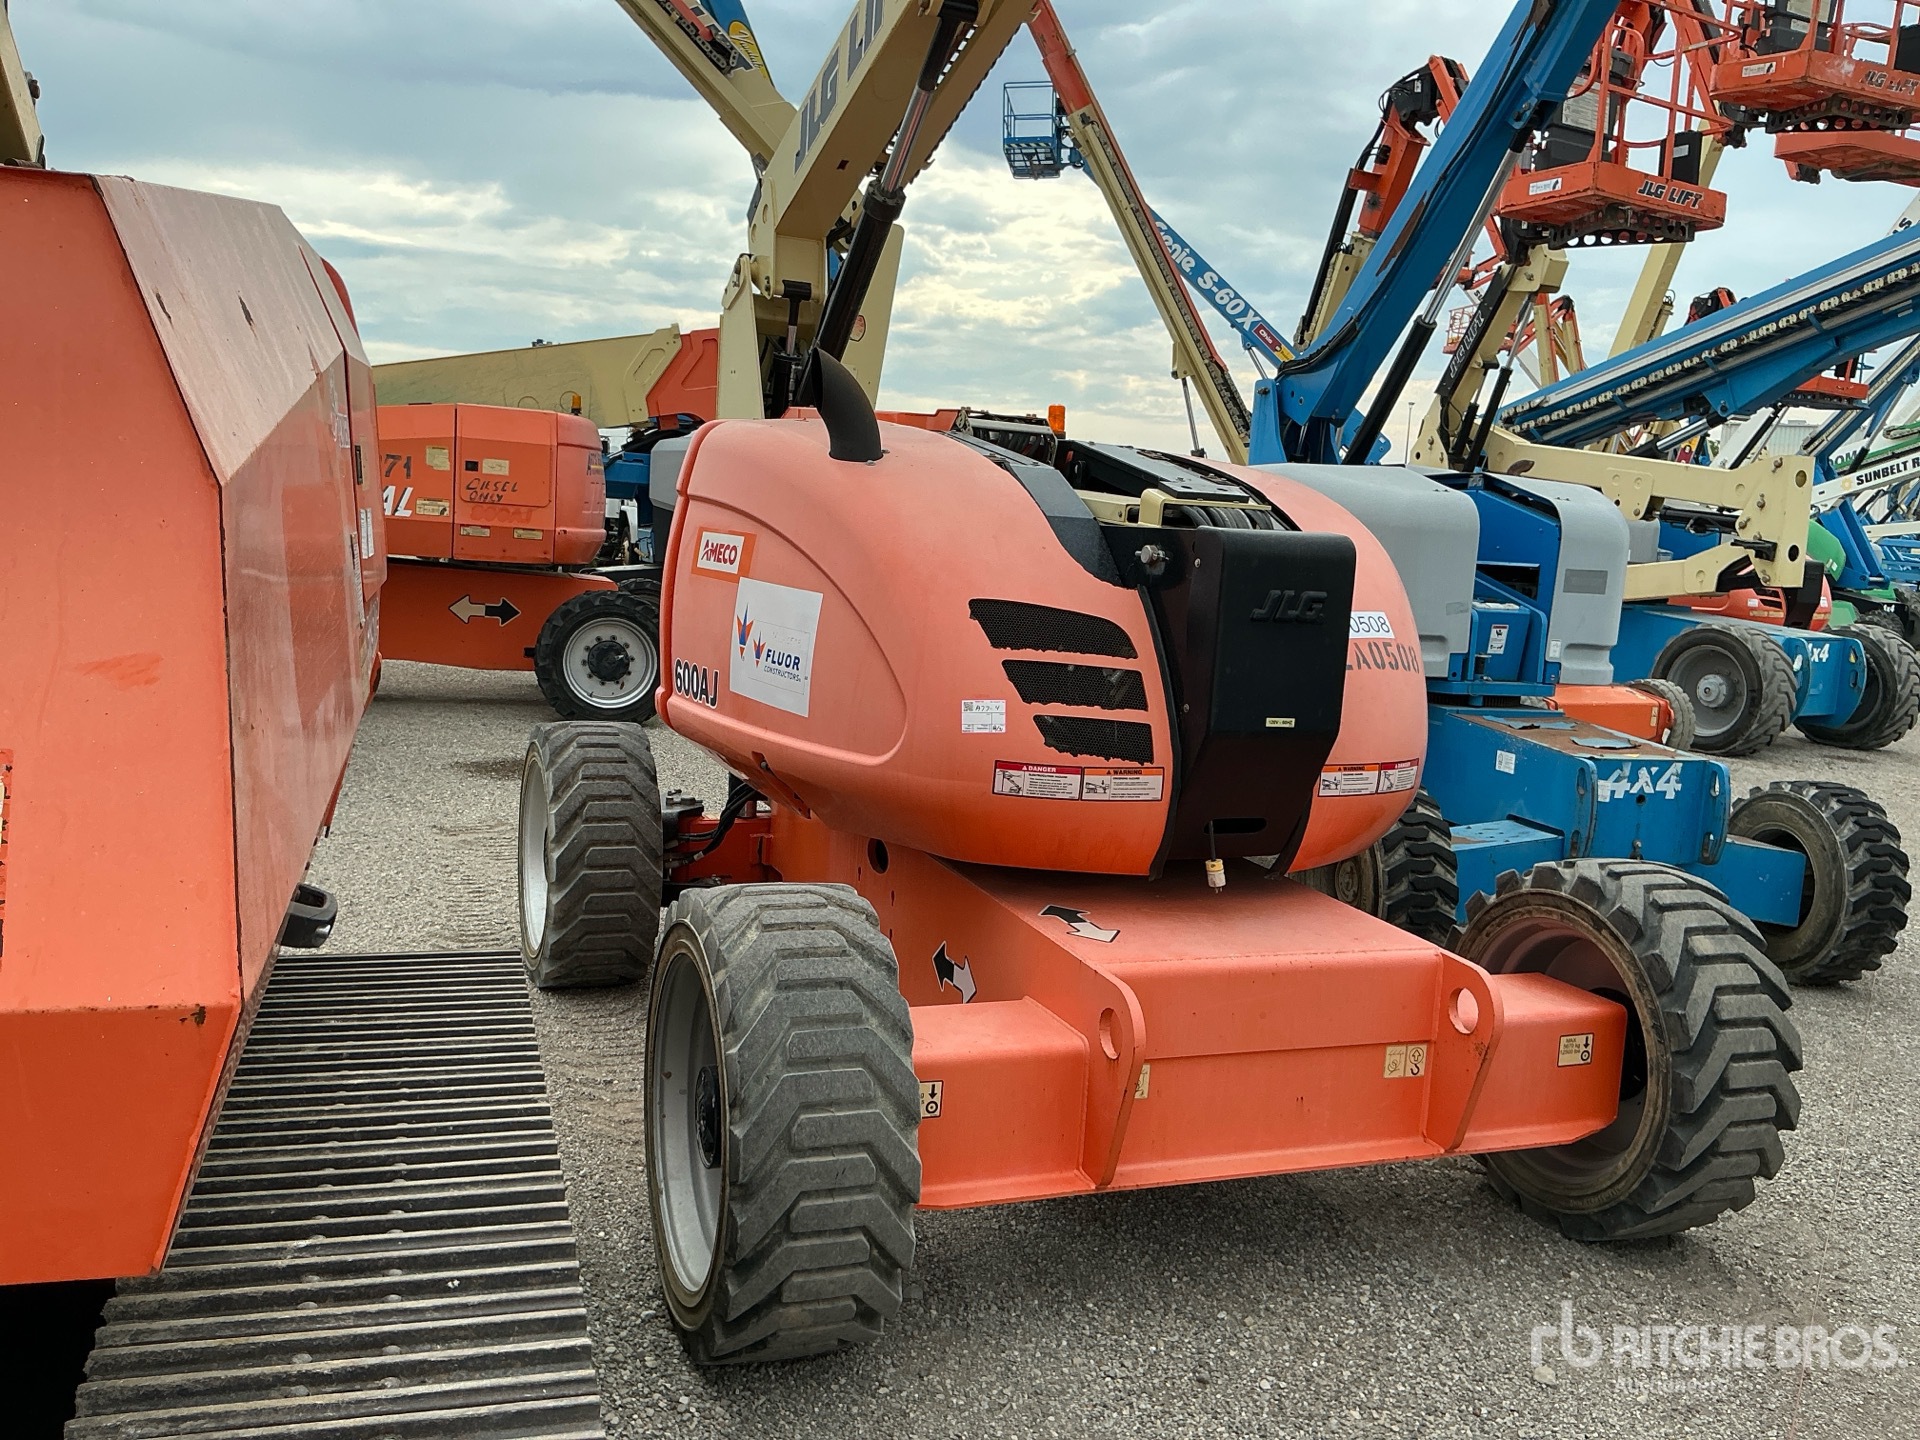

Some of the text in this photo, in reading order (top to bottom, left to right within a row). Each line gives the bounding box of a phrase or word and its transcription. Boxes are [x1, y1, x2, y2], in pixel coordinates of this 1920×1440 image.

[793, 46, 840, 176] JLG
[1637, 180, 1703, 209] JLG LIFT
[1856, 460, 1909, 486] SUNBELT
[701, 540, 737, 566] AMECO
[1250, 589, 1328, 624] JLG
[765, 648, 801, 671] FLUOR
[675, 658, 718, 709] 600AJ
